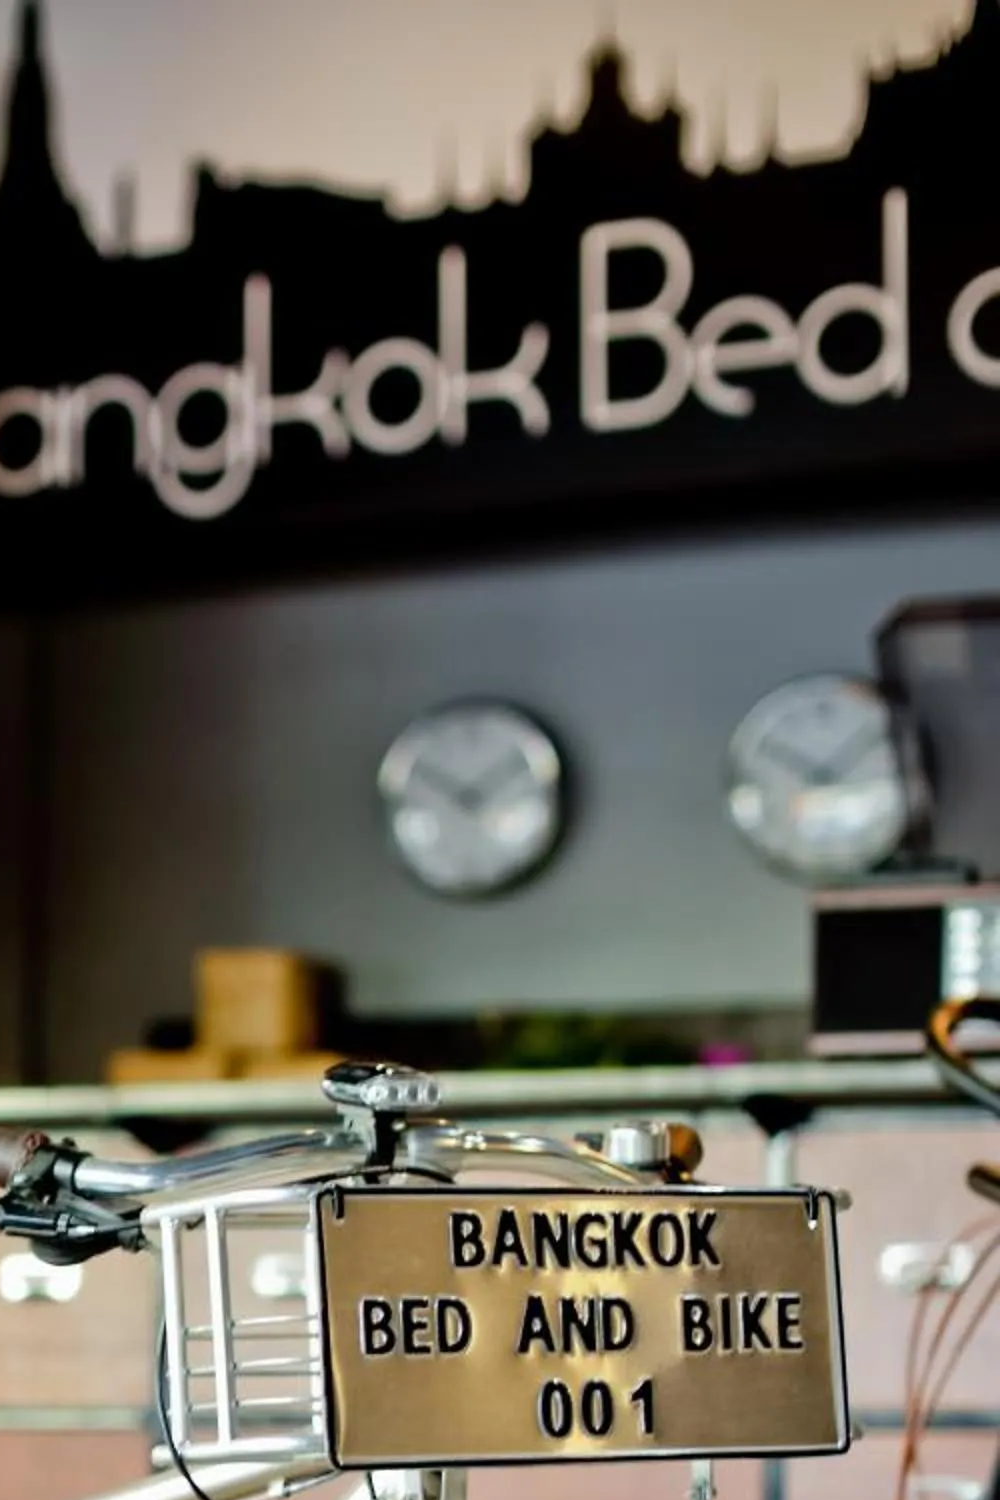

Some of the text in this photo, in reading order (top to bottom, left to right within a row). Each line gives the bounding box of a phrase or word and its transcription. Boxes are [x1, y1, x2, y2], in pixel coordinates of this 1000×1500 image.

[580, 186, 909, 434] Bed
[450, 1208, 721, 1270] BANGKOK
[360, 1294, 804, 1355] BED AND BIKE
[539, 1378, 655, 1438] 001
